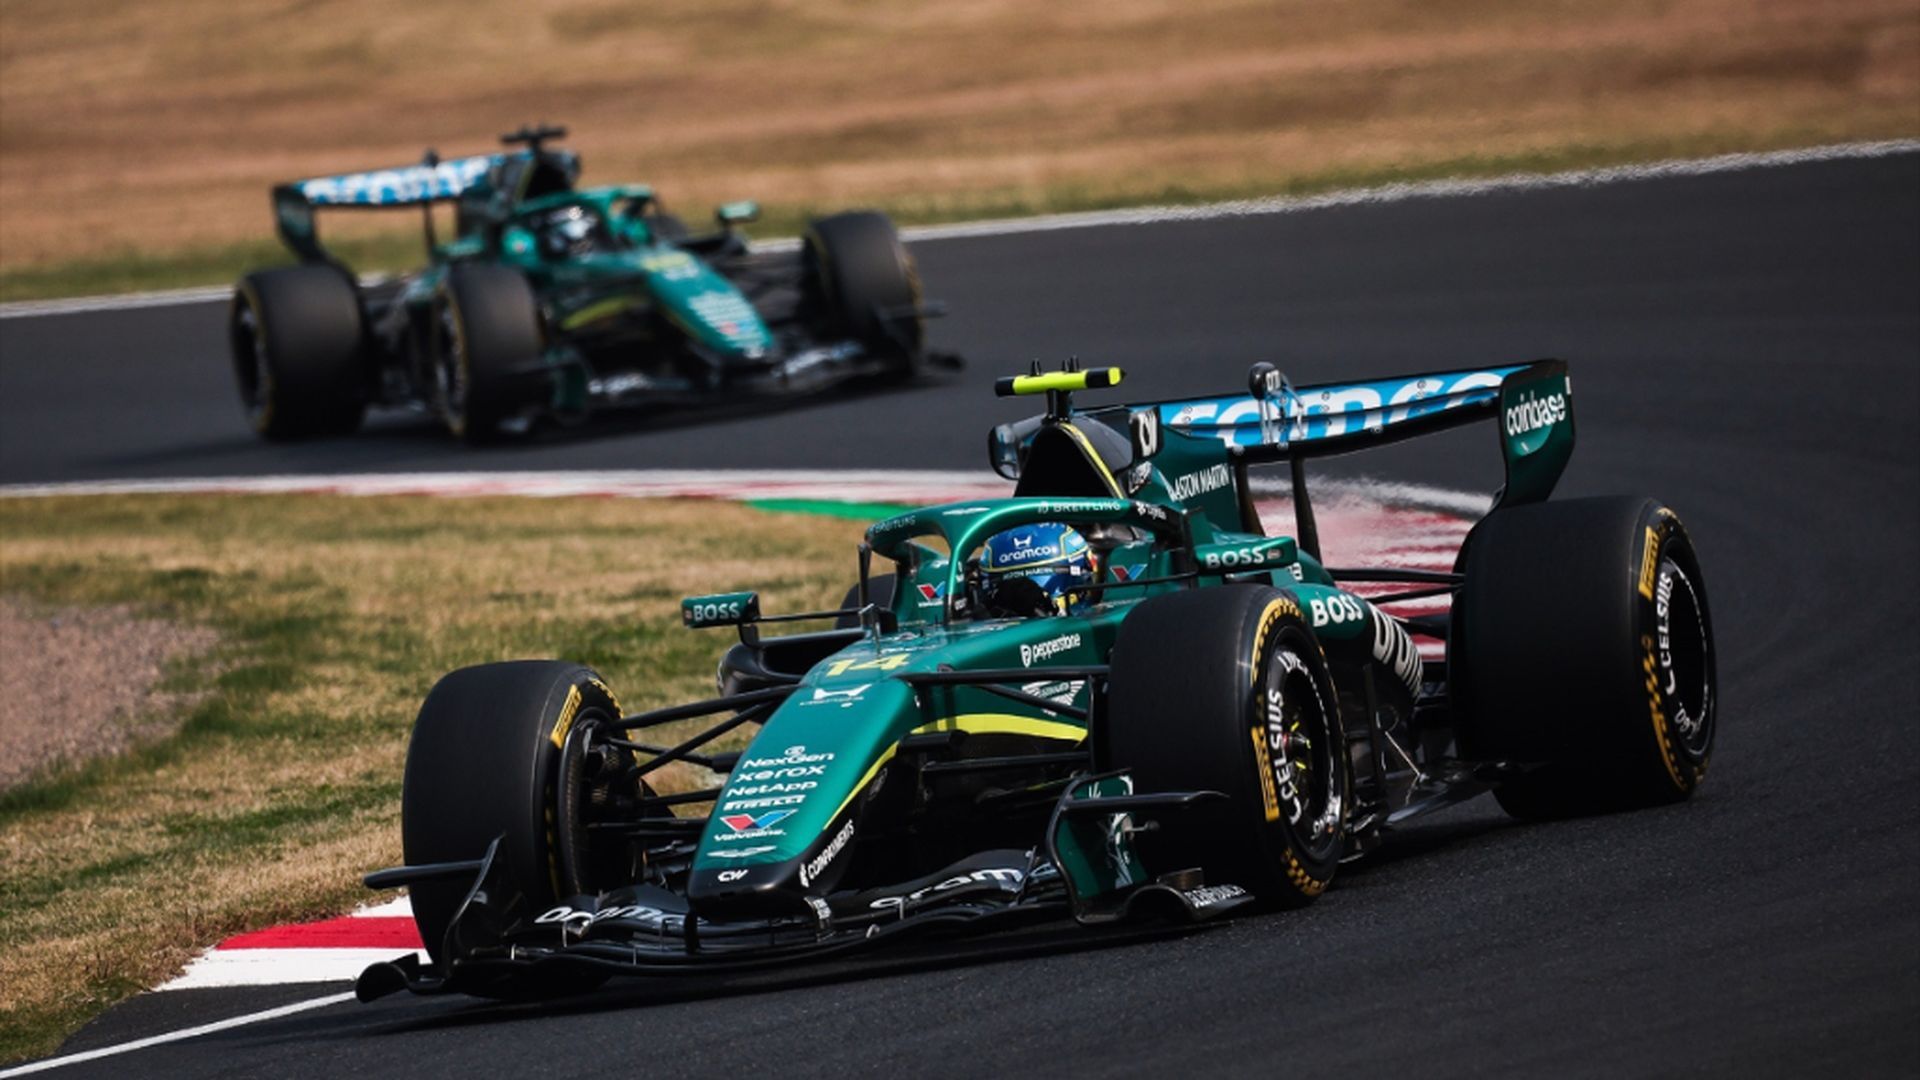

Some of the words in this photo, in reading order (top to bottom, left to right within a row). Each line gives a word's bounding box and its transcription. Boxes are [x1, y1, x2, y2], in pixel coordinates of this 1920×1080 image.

[1168, 372, 1504, 449] ramco
[1507, 390, 1566, 436] coinbase
[1172, 473, 1200, 502] ASTON
[1200, 463, 1229, 494] MARTIN
[1053, 500, 1121, 513] BREITLING
[999, 545, 1051, 563] aramco
[1206, 546, 1265, 569] BOSS
[693, 602, 741, 622] BOSS
[1311, 594, 1363, 627] BOSS
[1657, 572, 1674, 666] CELSIUS
[1032, 633, 1081, 663] pepperstone
[826, 652, 909, 677] 14
[1268, 688, 1300, 800] CELSIUS
[743, 752, 835, 769] NexGen
[735, 765, 827, 783] xerox
[726, 781, 818, 798] NetApp
[723, 794, 806, 811] PIRELLI
[717, 869, 749, 882] CW
